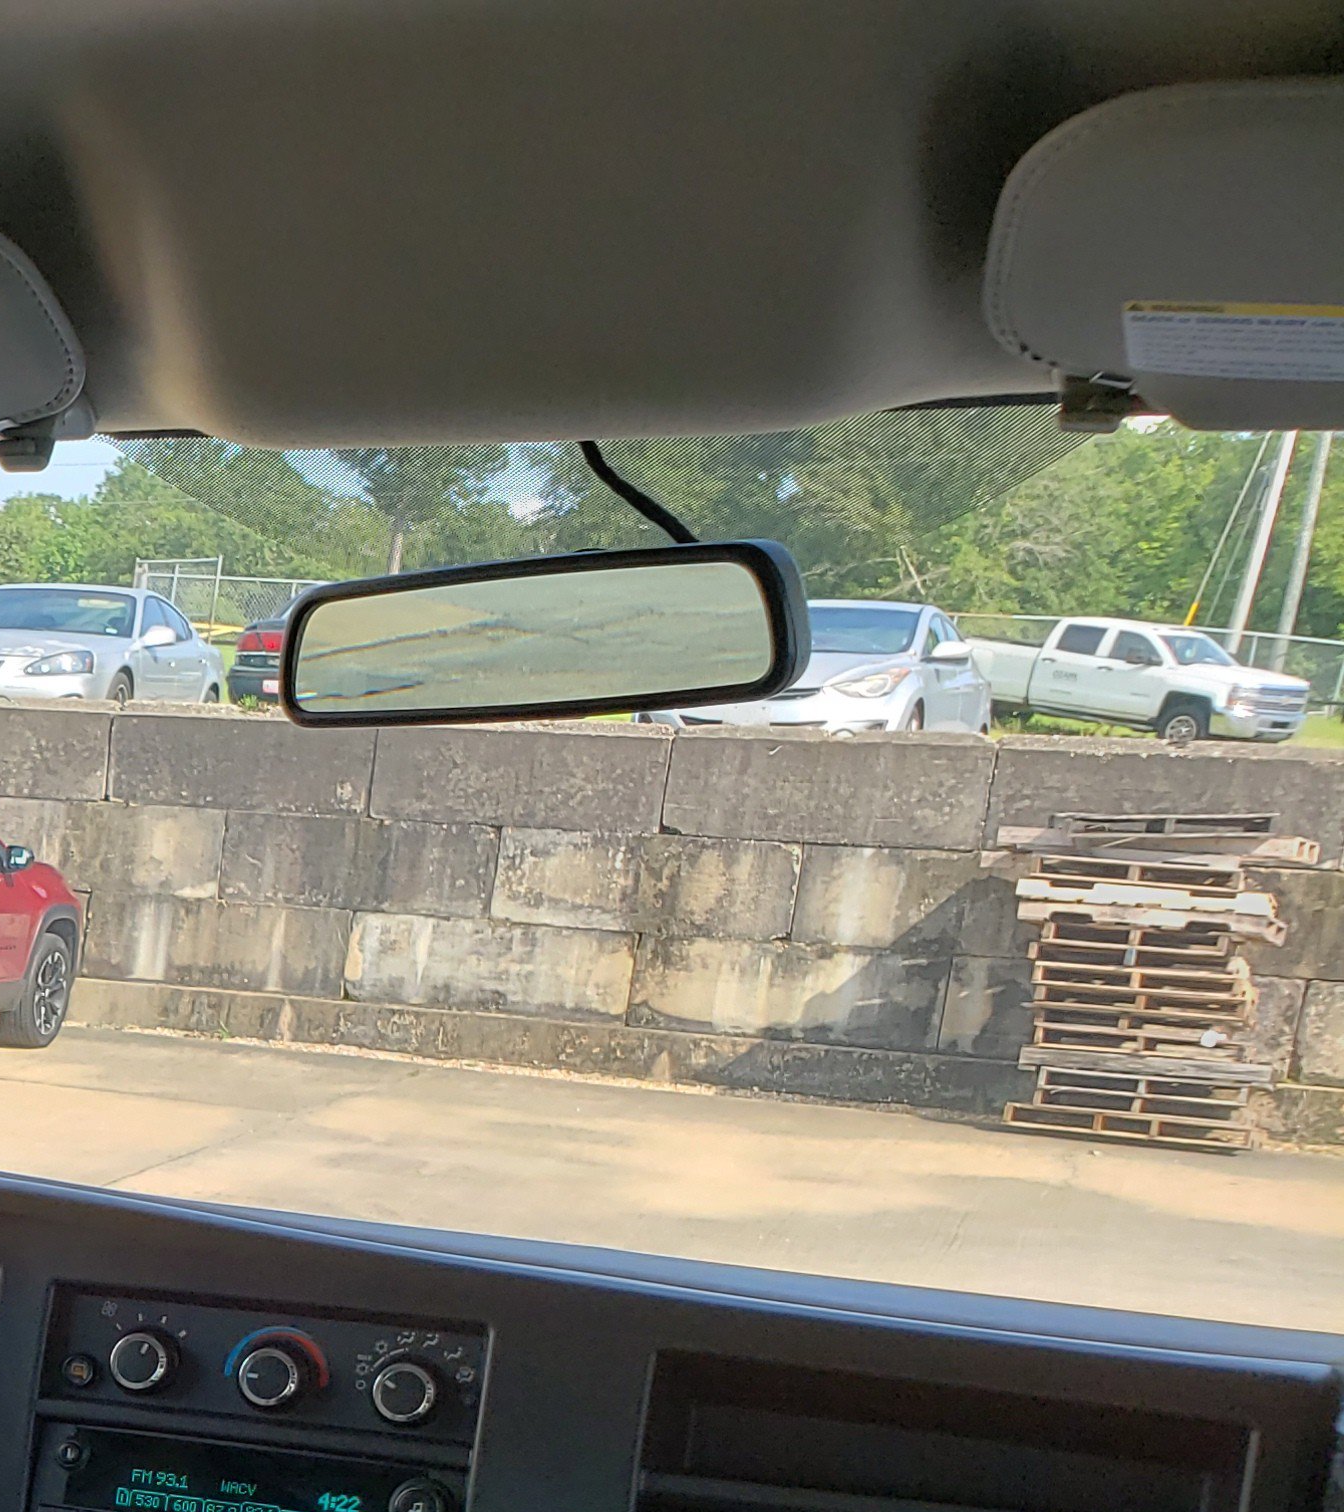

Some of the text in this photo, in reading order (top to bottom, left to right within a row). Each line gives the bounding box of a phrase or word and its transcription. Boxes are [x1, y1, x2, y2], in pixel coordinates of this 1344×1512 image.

[131, 1469, 188, 1489] FM 93.1
[135, 1494, 160, 1509] 530
